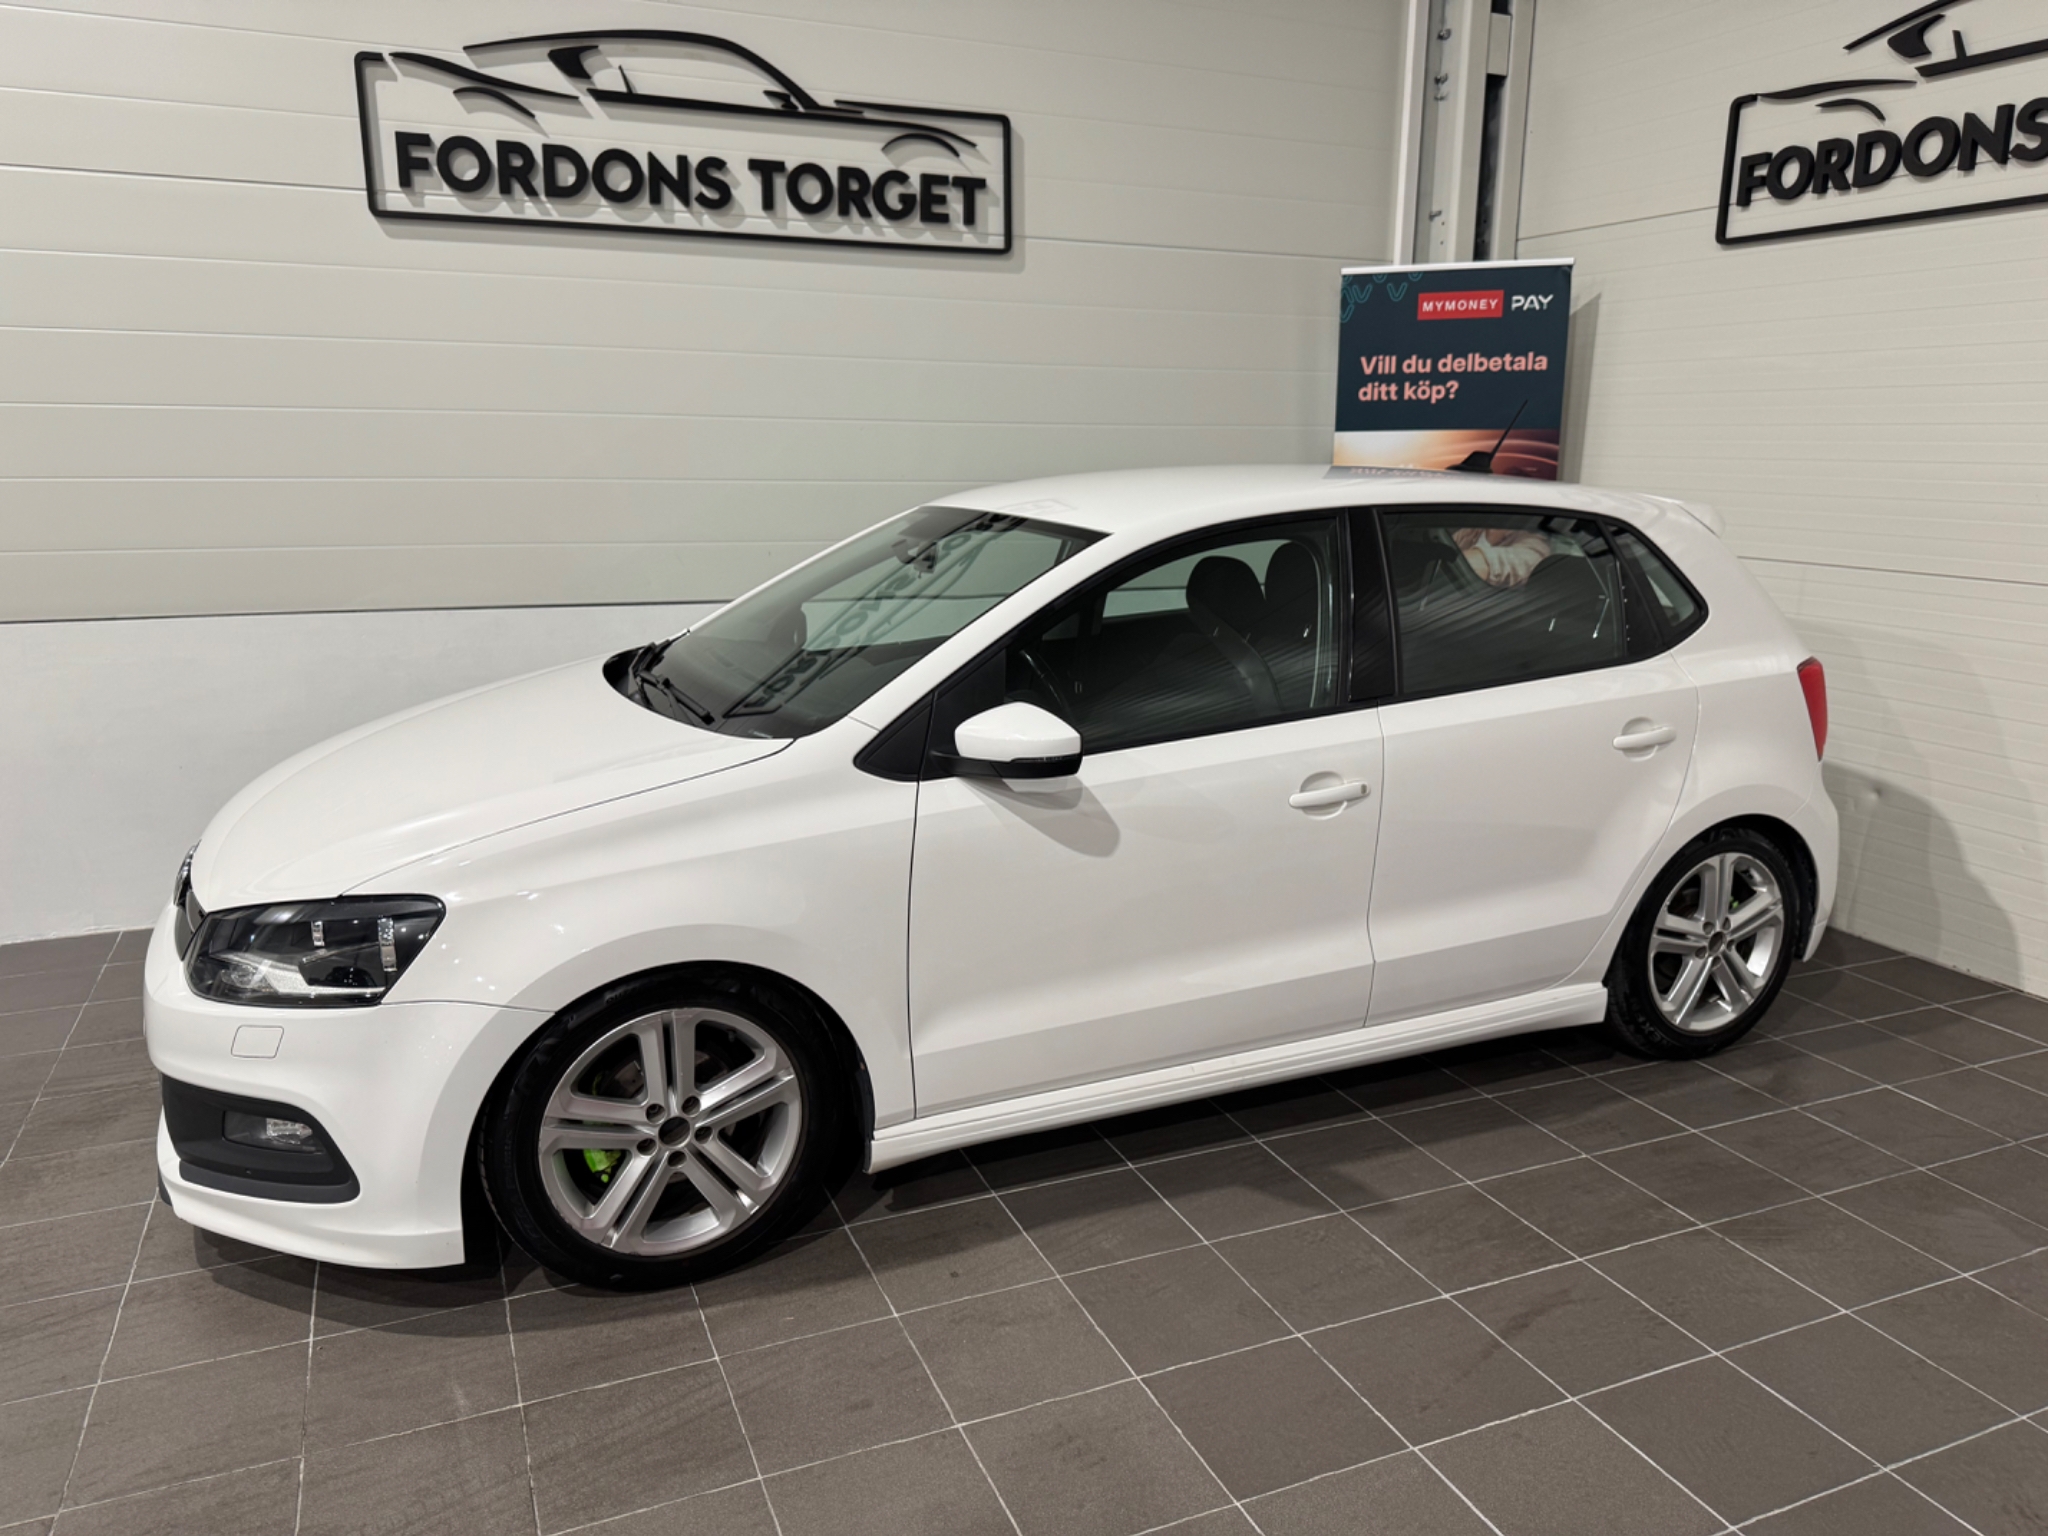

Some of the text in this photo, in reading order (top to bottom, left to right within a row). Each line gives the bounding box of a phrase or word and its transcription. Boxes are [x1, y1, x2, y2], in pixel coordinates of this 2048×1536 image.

[1736, 97, 2048, 207] FORDONS
[395, 131, 986, 226] FORDONS TORGET
[1422, 294, 1553, 312] MYMONEY PAY
[1360, 351, 1548, 375] Vill du delbetala
[1358, 380, 1459, 404] ditt köp?
